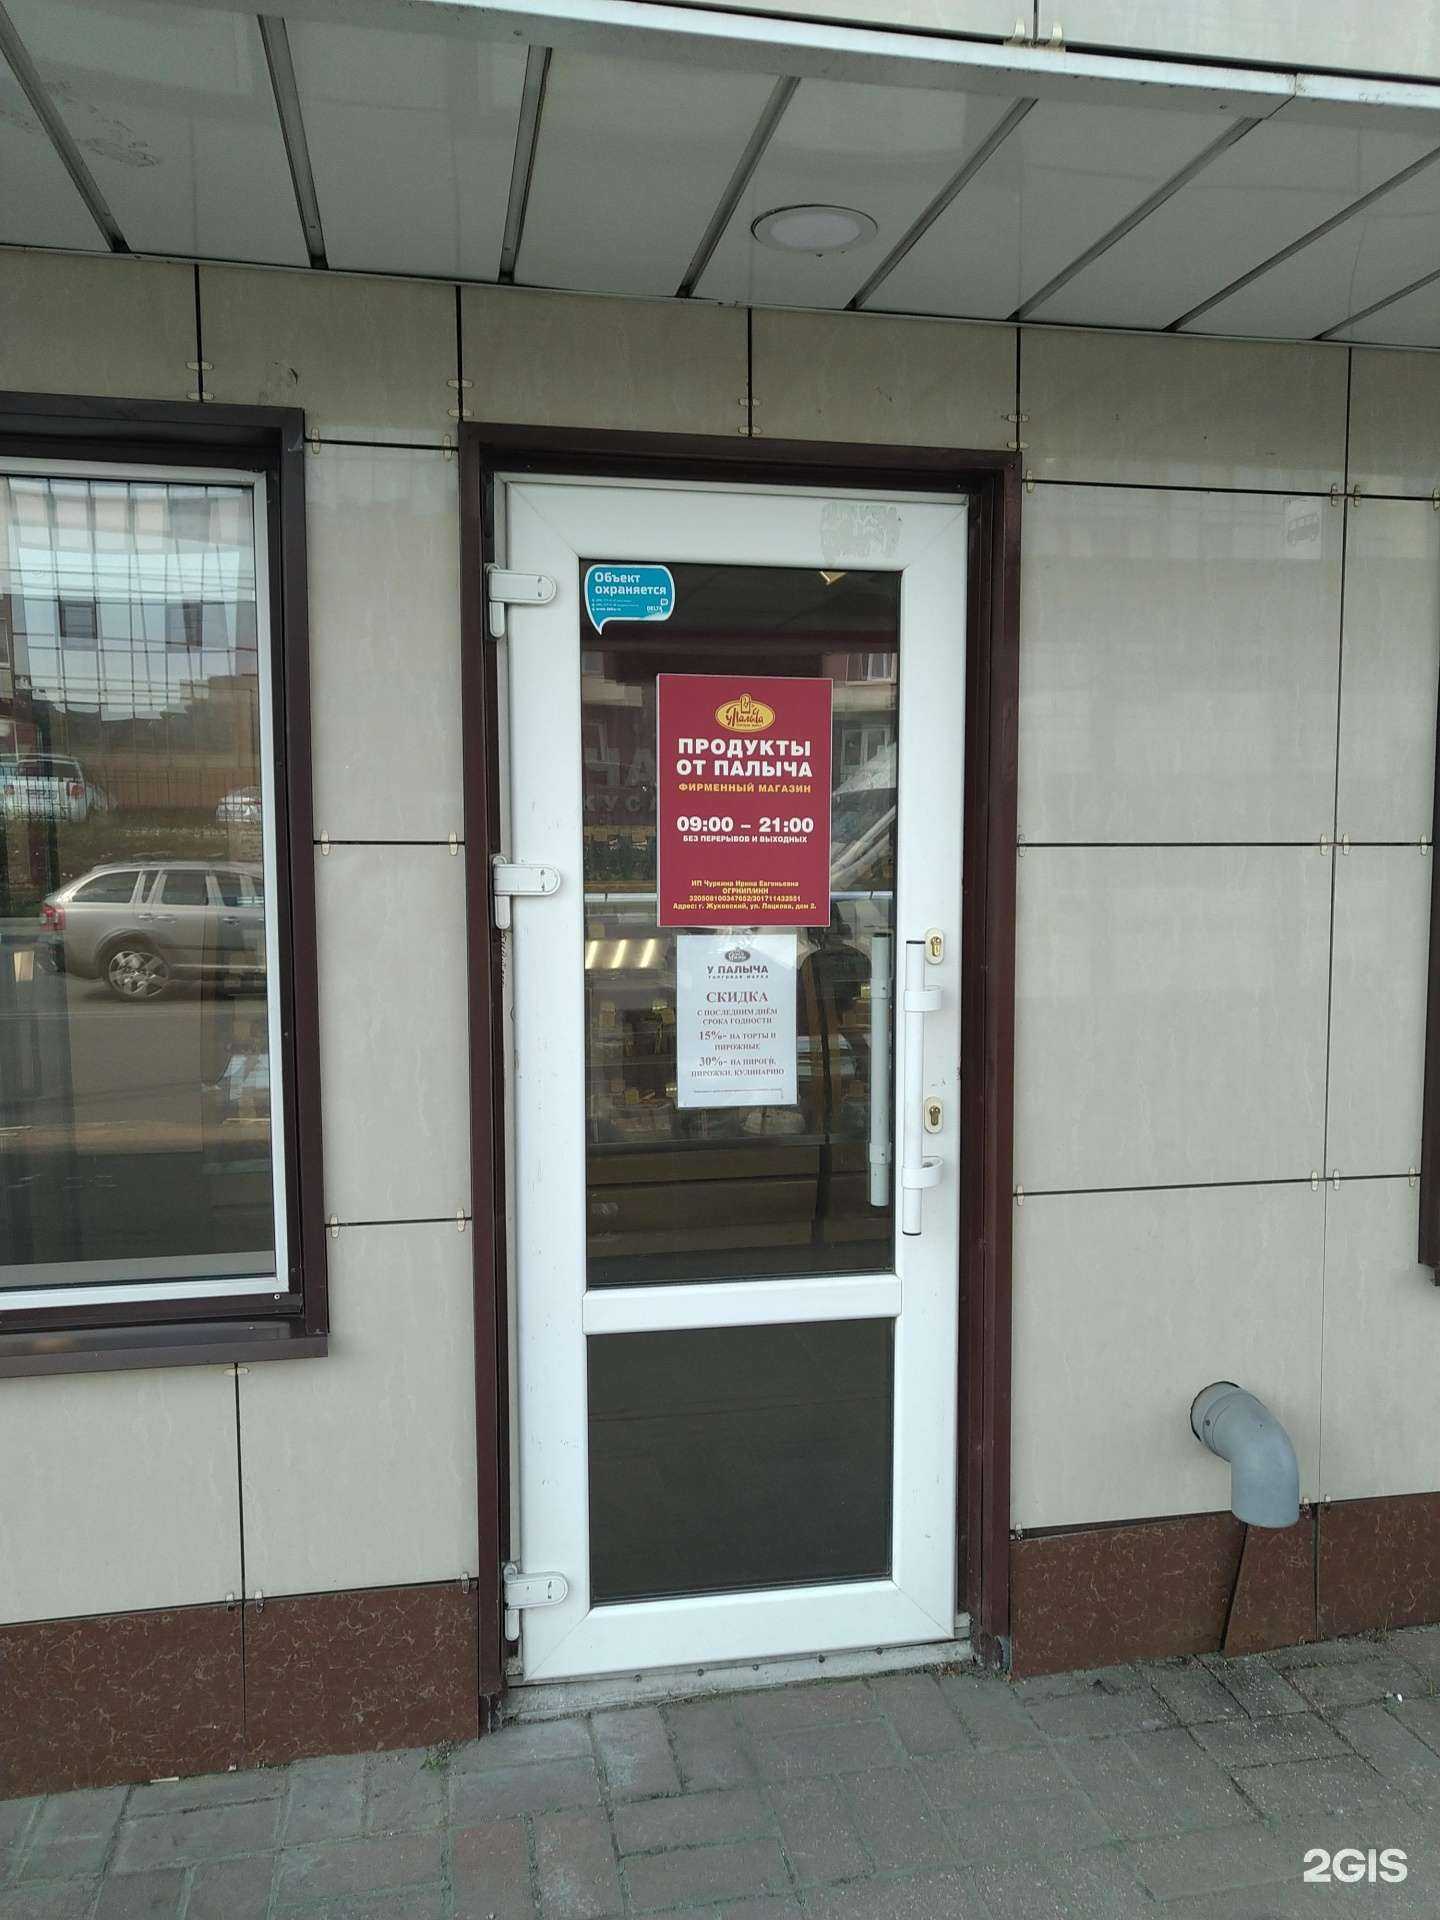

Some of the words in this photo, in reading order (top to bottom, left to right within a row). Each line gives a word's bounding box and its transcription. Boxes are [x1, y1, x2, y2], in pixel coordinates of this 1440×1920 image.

[594, 571, 641, 583] Объект
[595, 585, 667, 597] охраняется
[677, 738, 811, 758] ПРОДУКТЫ
[676, 759, 706, 776] ОТ
[714, 759, 812, 777] ПАЛЫЧА
[678, 782, 754, 793] ФИРМЕННЫЙ
[758, 783, 811, 793] МАГАЗИН
[676, 816, 734, 832] 09:00
[759, 817, 814, 833] 21:00
[700, 835, 750, 843] ПЕРЕРЫВОВ
[760, 836, 808, 844] ВЫХОДНЫХ
[707, 966, 714, 974] У
[718, 965, 769, 974] ПАЛЫЧА
[706, 991, 769, 1004] СКИДКА
[704, 1008, 754, 1017] ПОСЛЕДНИМ
[730, 1017, 772, 1025] ГОДНОСТИ
